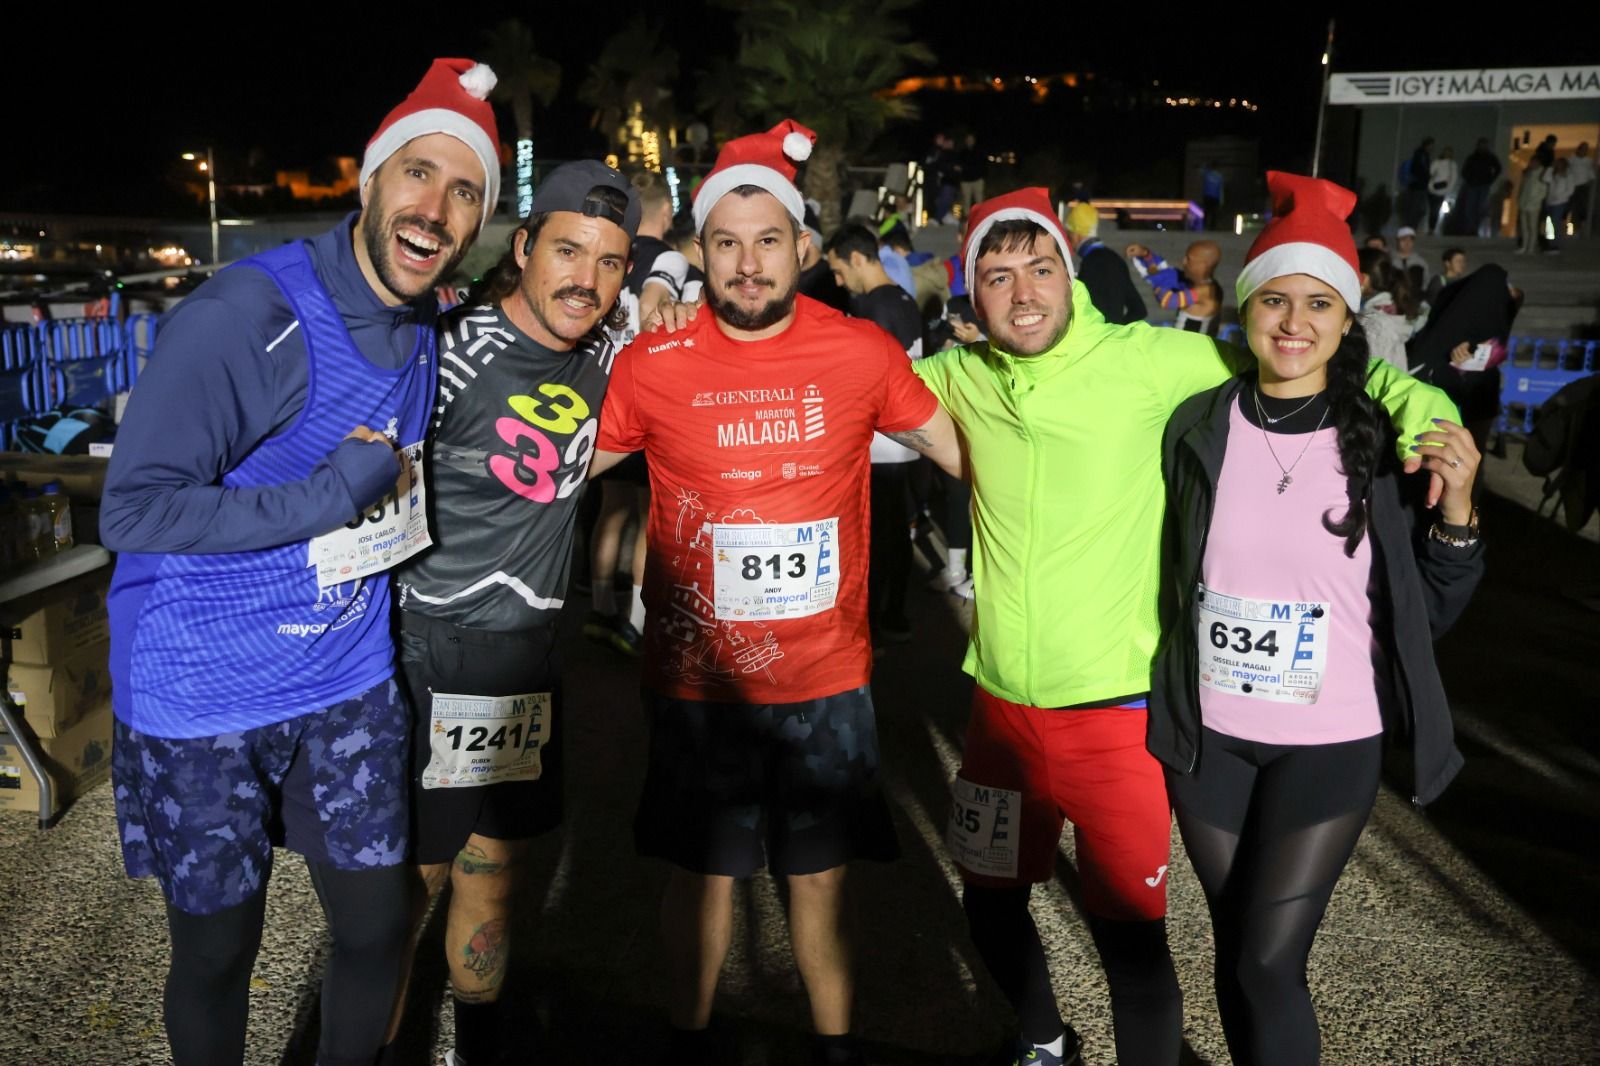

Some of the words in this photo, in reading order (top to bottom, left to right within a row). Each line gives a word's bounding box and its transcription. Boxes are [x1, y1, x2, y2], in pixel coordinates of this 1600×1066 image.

[1448, 69, 1551, 95] MÁLAGA
[716, 388, 795, 404] GENERALI
[755, 408, 795, 420] MARATÓN
[717, 418, 800, 448] MÁLAGA
[721, 469, 762, 480] málaga
[358, 535, 373, 544] JOSE
[375, 526, 397, 540] CARLOS
[372, 529, 406, 552] mayoral
[741, 552, 806, 581] 813
[766, 592, 808, 604] mayoral
[277, 623, 328, 637] mayor
[1209, 621, 1279, 657] 634
[1212, 655, 1240, 667] GISSELLE
[1242, 662, 1271, 672] MAGALI
[1232, 670, 1280, 684] mayoral
[446, 724, 523, 752] 1241
